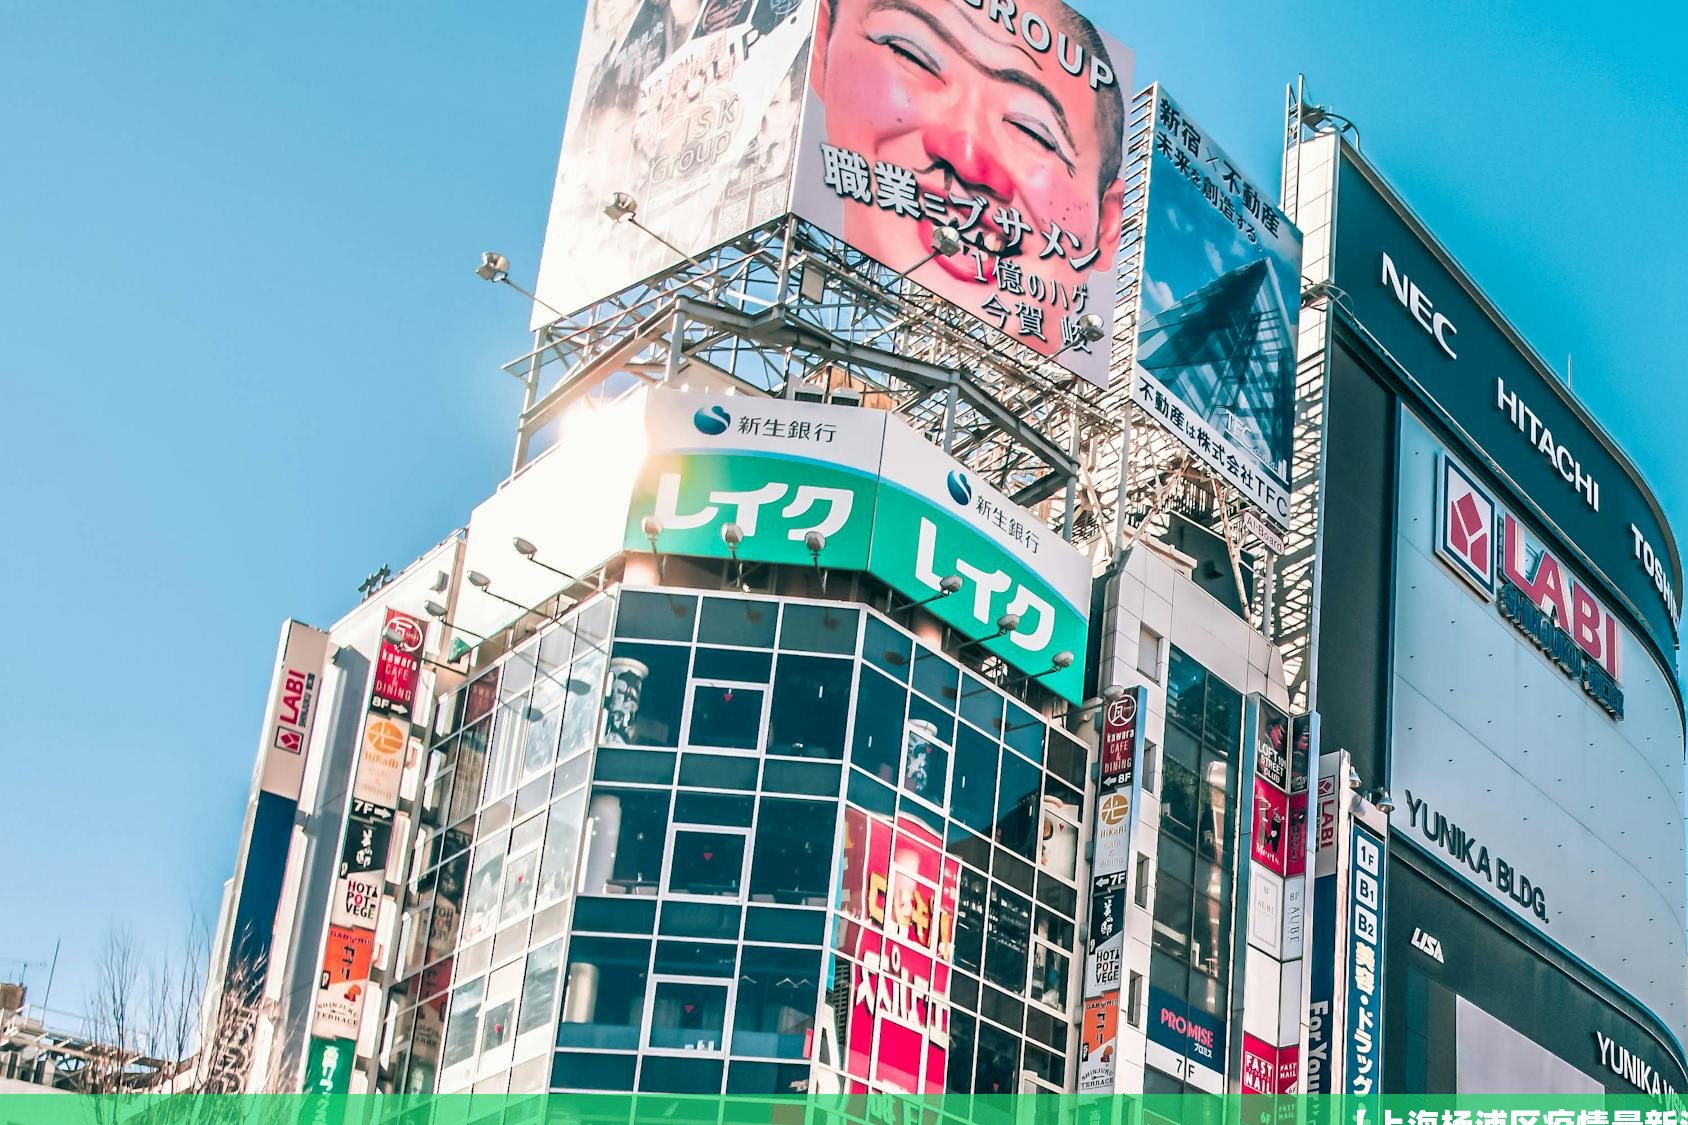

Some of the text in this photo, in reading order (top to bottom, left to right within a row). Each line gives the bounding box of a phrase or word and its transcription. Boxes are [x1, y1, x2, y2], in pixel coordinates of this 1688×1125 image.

[964, 0, 1114, 90] ROUP
[1382, 251, 1458, 361] NEC
[738, 415, 838, 444] 新生銀行
[1498, 376, 1600, 512] HITACHI
[654, 472, 855, 542] レイク
[975, 493, 1041, 555] 新生銀行
[914, 516, 1056, 652] レイク
[1503, 510, 1619, 680] LABI
[279, 668, 307, 725] LABI
[371, 696, 391, 713] 8F
[1109, 741, 1129, 754] CAFE
[1258, 739, 1279, 762] LOFT
[1104, 758, 1132, 774] DINING
[1260, 754, 1284, 777] STREET
[1117, 772, 1132, 784] 8F
[1320, 799, 1334, 849] LABI
[1361, 844, 1374, 867] 1F
[1405, 789, 1550, 924] YUNIKA BLDG.
[348, 880, 372, 897] HOT
[1110, 872, 1126, 886] 7F
[1359, 878, 1375, 903] B1
[347, 892, 370, 908] POT
[345, 904, 375, 920] VEGE
[1358, 912, 1375, 937] B2
[1096, 949, 1115, 963] HOT
[1096, 960, 1115, 973] POT
[1096, 970, 1118, 984] VEGE
[1160, 1007, 1214, 1049] PROMISE
[1308, 1000, 1329, 1041] For
[1175, 1057, 1196, 1079] 7F
[1246, 1053, 1273, 1074] FAST
[1279, 1062, 1297, 1073] FAST
[1279, 1070, 1297, 1079] NAIL
[1596, 1030, 1663, 1105] YUNIKA
[1245, 1073, 1272, 1096] NAIL
